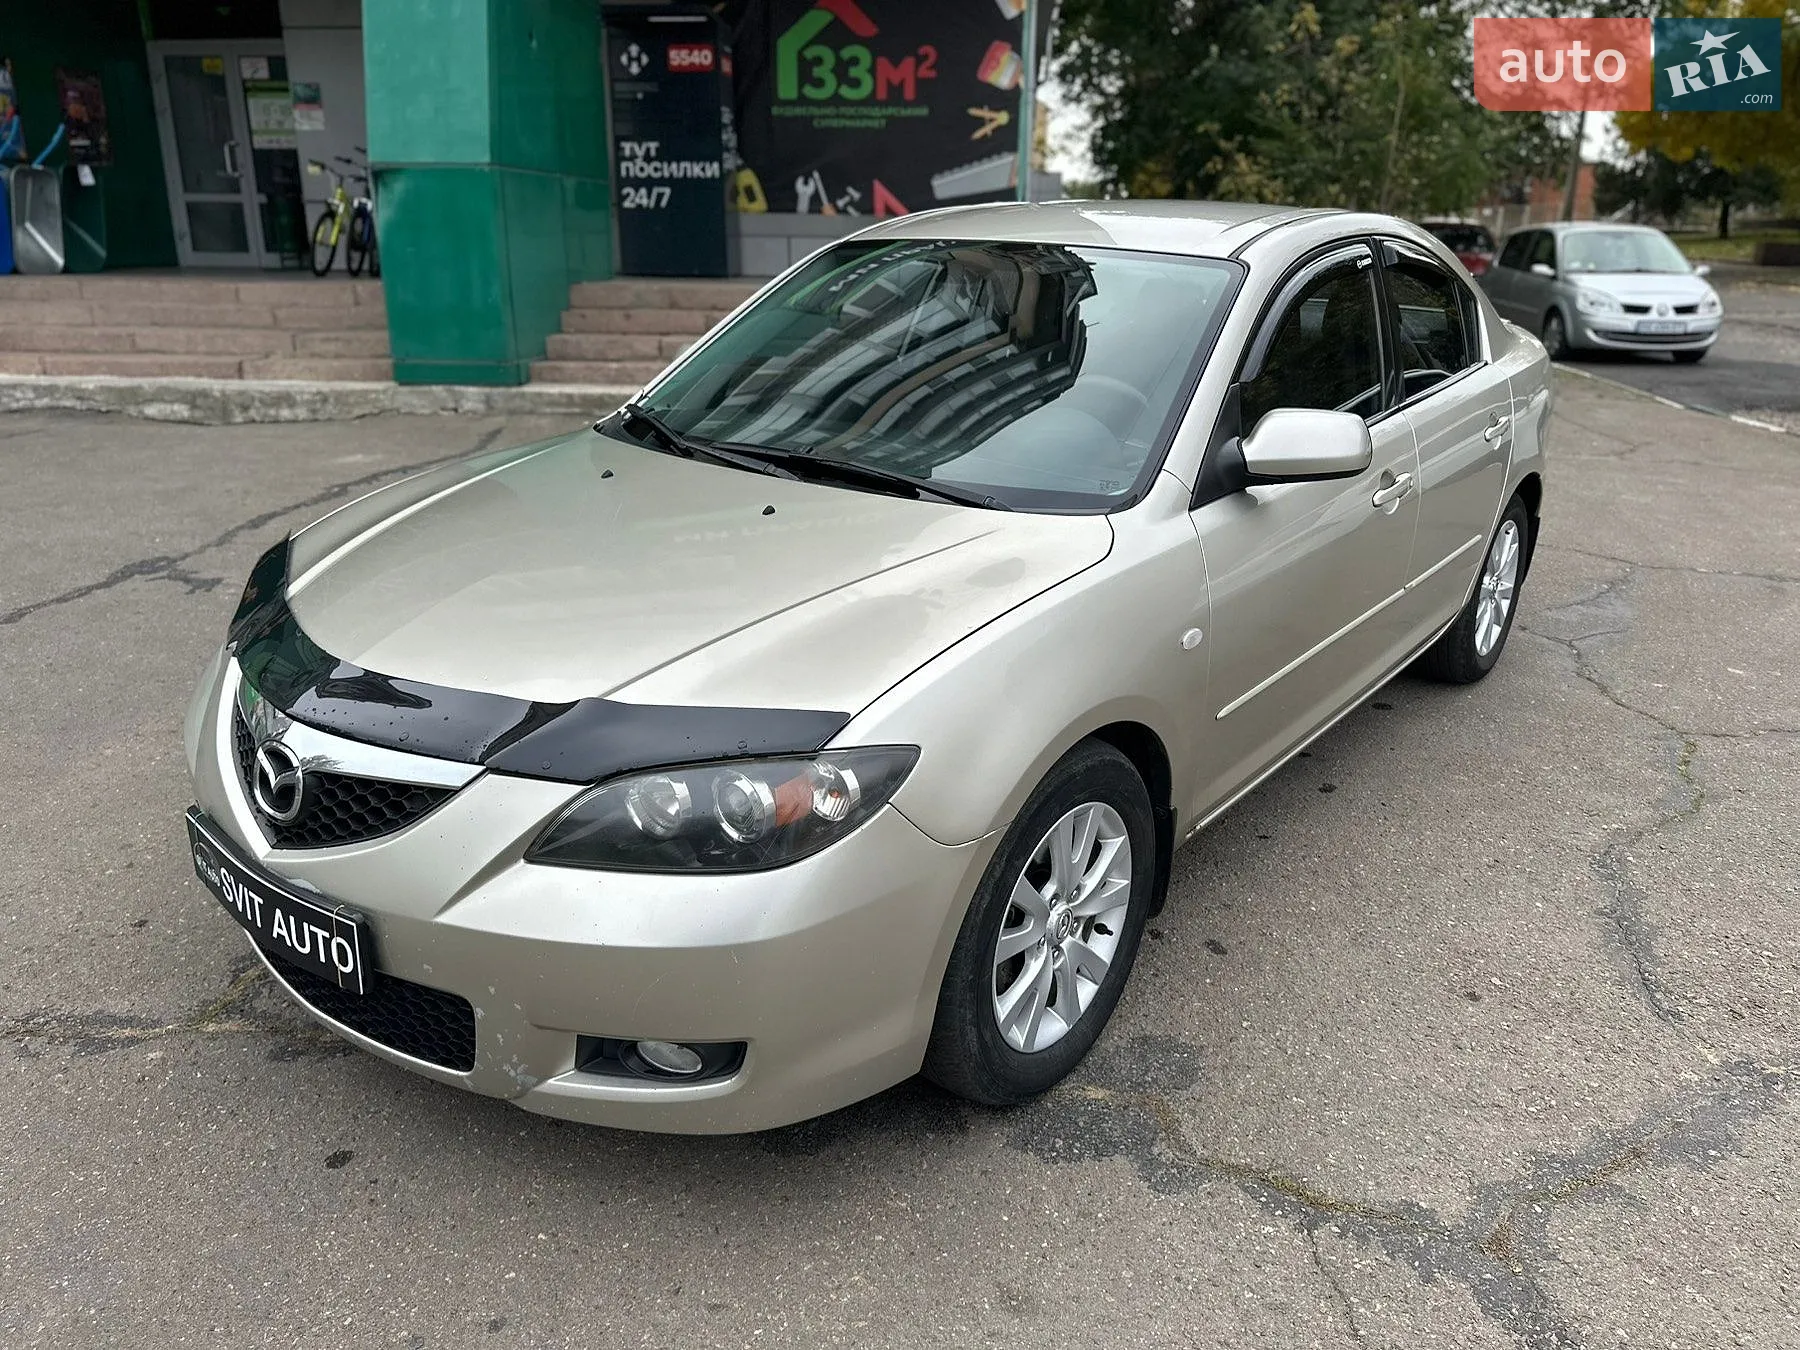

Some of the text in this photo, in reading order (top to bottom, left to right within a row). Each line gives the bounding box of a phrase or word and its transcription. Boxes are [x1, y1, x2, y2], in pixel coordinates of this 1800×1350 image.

[669, 51, 713, 67] 5540
[620, 187, 671, 209] 24/7
[220, 867, 264, 929] SVIT
[272, 908, 354, 974] AUTO
